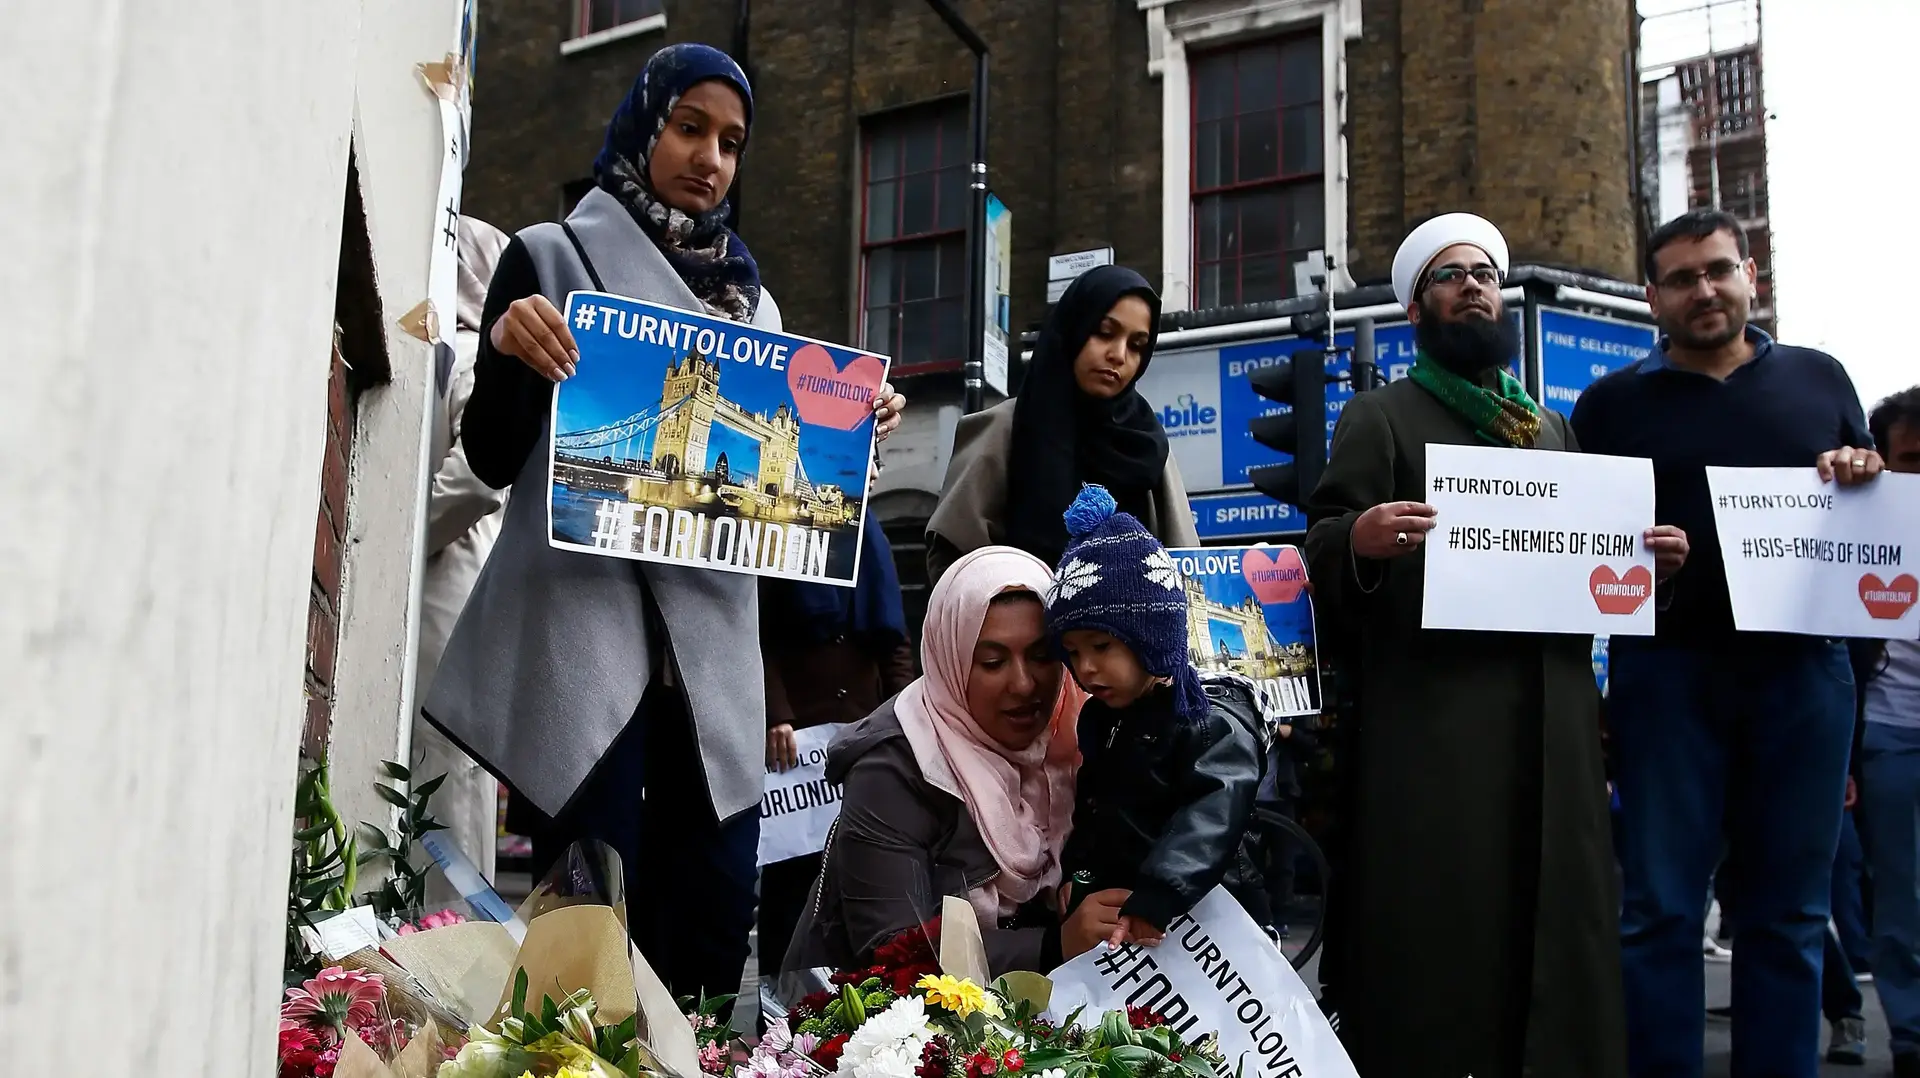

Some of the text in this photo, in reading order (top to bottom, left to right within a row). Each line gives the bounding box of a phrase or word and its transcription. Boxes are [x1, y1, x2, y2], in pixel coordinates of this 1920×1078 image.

[1069, 260, 1094, 269] STREET
[575, 303, 788, 371] #TURNTOLOVE
[1546, 331, 1576, 347] FINE
[1590, 363, 1608, 378] OF
[796, 374, 872, 404] #TURNTOLOVE
[1433, 476, 1558, 498] #TURNTOLOVE
[1719, 494, 1833, 510] #TURNTOLOVE
[1216, 504, 1290, 523] SPIRITS
[591, 499, 830, 579] #FORLONDON
[1449, 526, 1634, 557] #ISIS=ENEMIES OF ISLAM
[1742, 537, 1901, 566] #ISIS=ENEMIES OF ISLAM
[1171, 555, 1241, 576] TOLOVE
[1252, 568, 1301, 584] #TURNTOLOVE
[1596, 583, 1645, 597] #TURNTOLOVE
[1864, 590, 1912, 603] #TURNTOLOVE
[1169, 912, 1303, 1078] TURNTOLOVE
